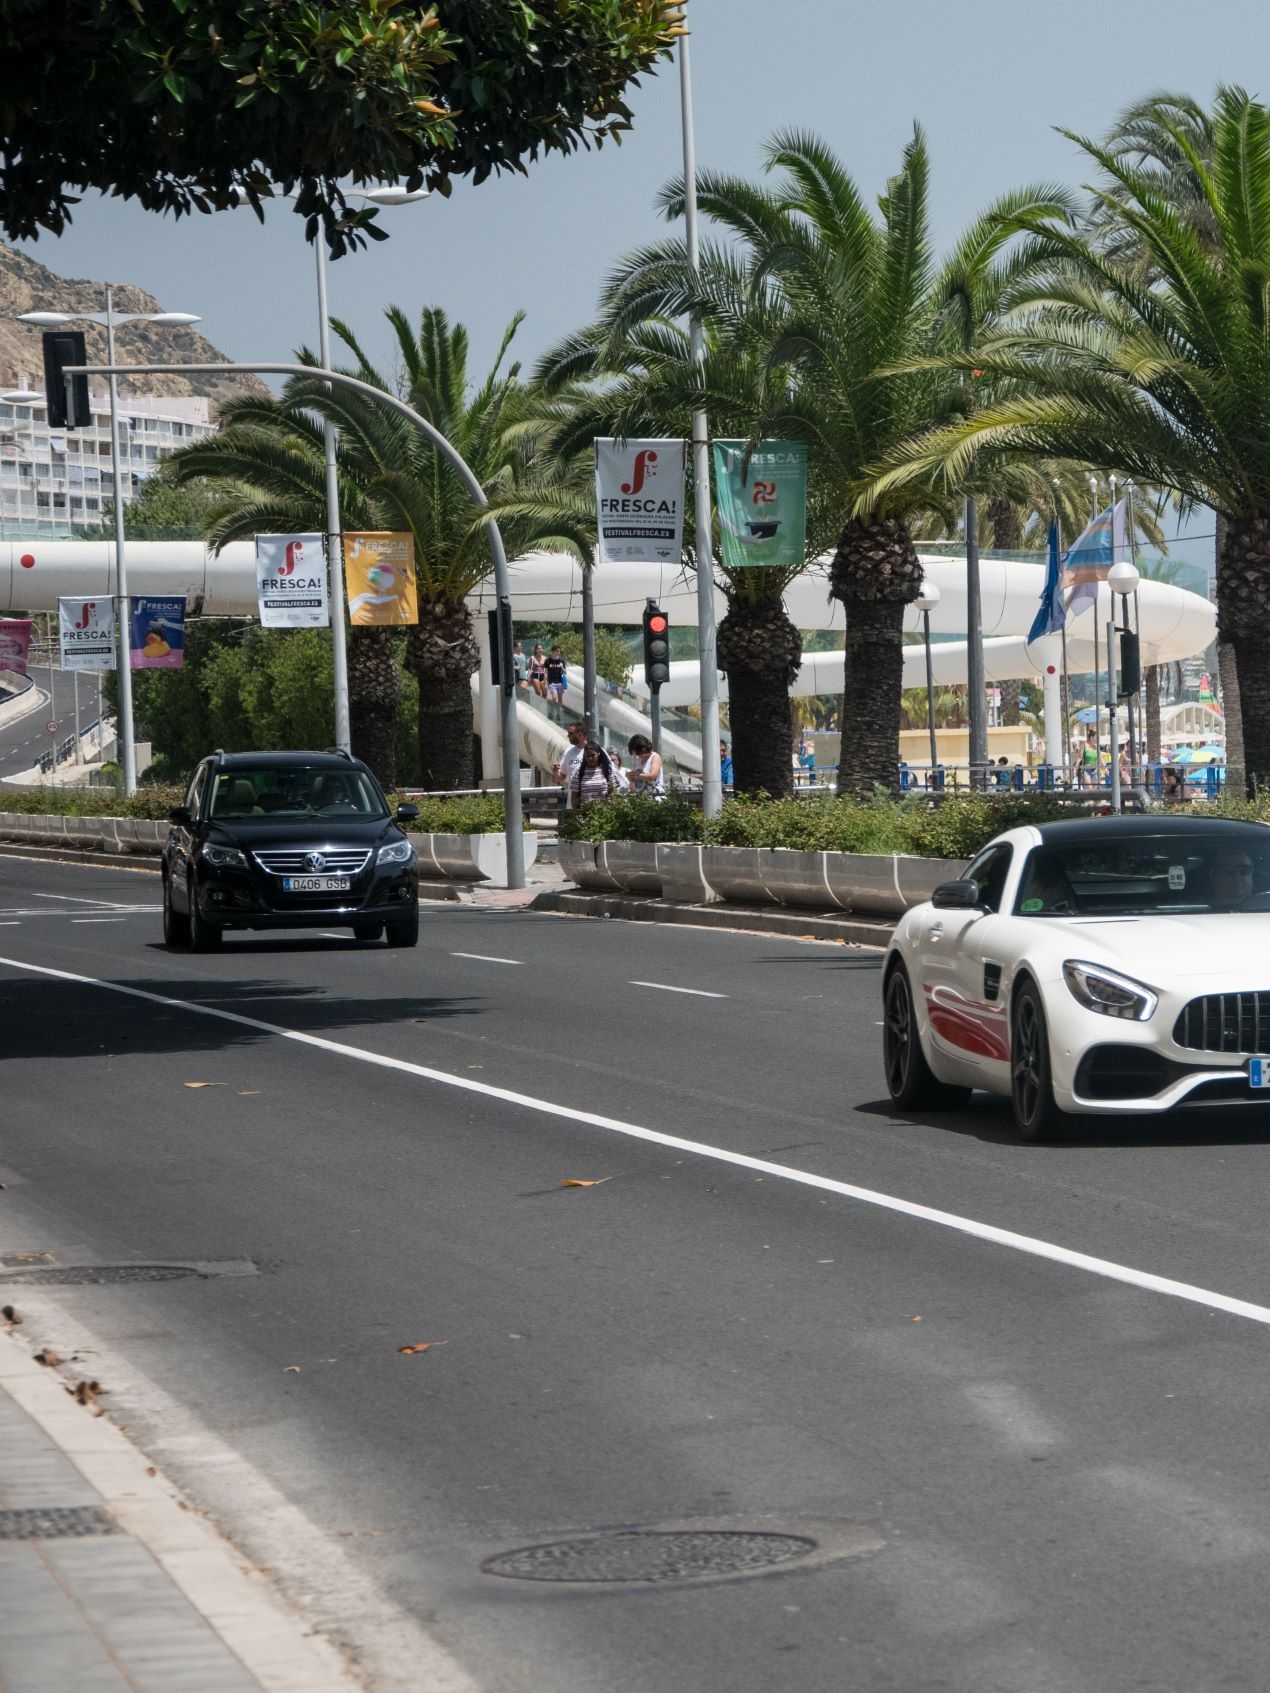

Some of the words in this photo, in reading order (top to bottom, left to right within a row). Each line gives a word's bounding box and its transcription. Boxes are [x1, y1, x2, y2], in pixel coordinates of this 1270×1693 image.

[601, 498, 676, 514] FRESCA!
[605, 529, 670, 537] FESTIVALFRESCA.ES
[366, 542, 408, 552] FRESCA!
[262, 578, 321, 589] FRESCA!
[146, 602, 182, 610] FRESCA!
[63, 630, 111, 640] FRESCA!
[294, 879, 321, 890] 0406
[326, 878, 347, 888] GSB
